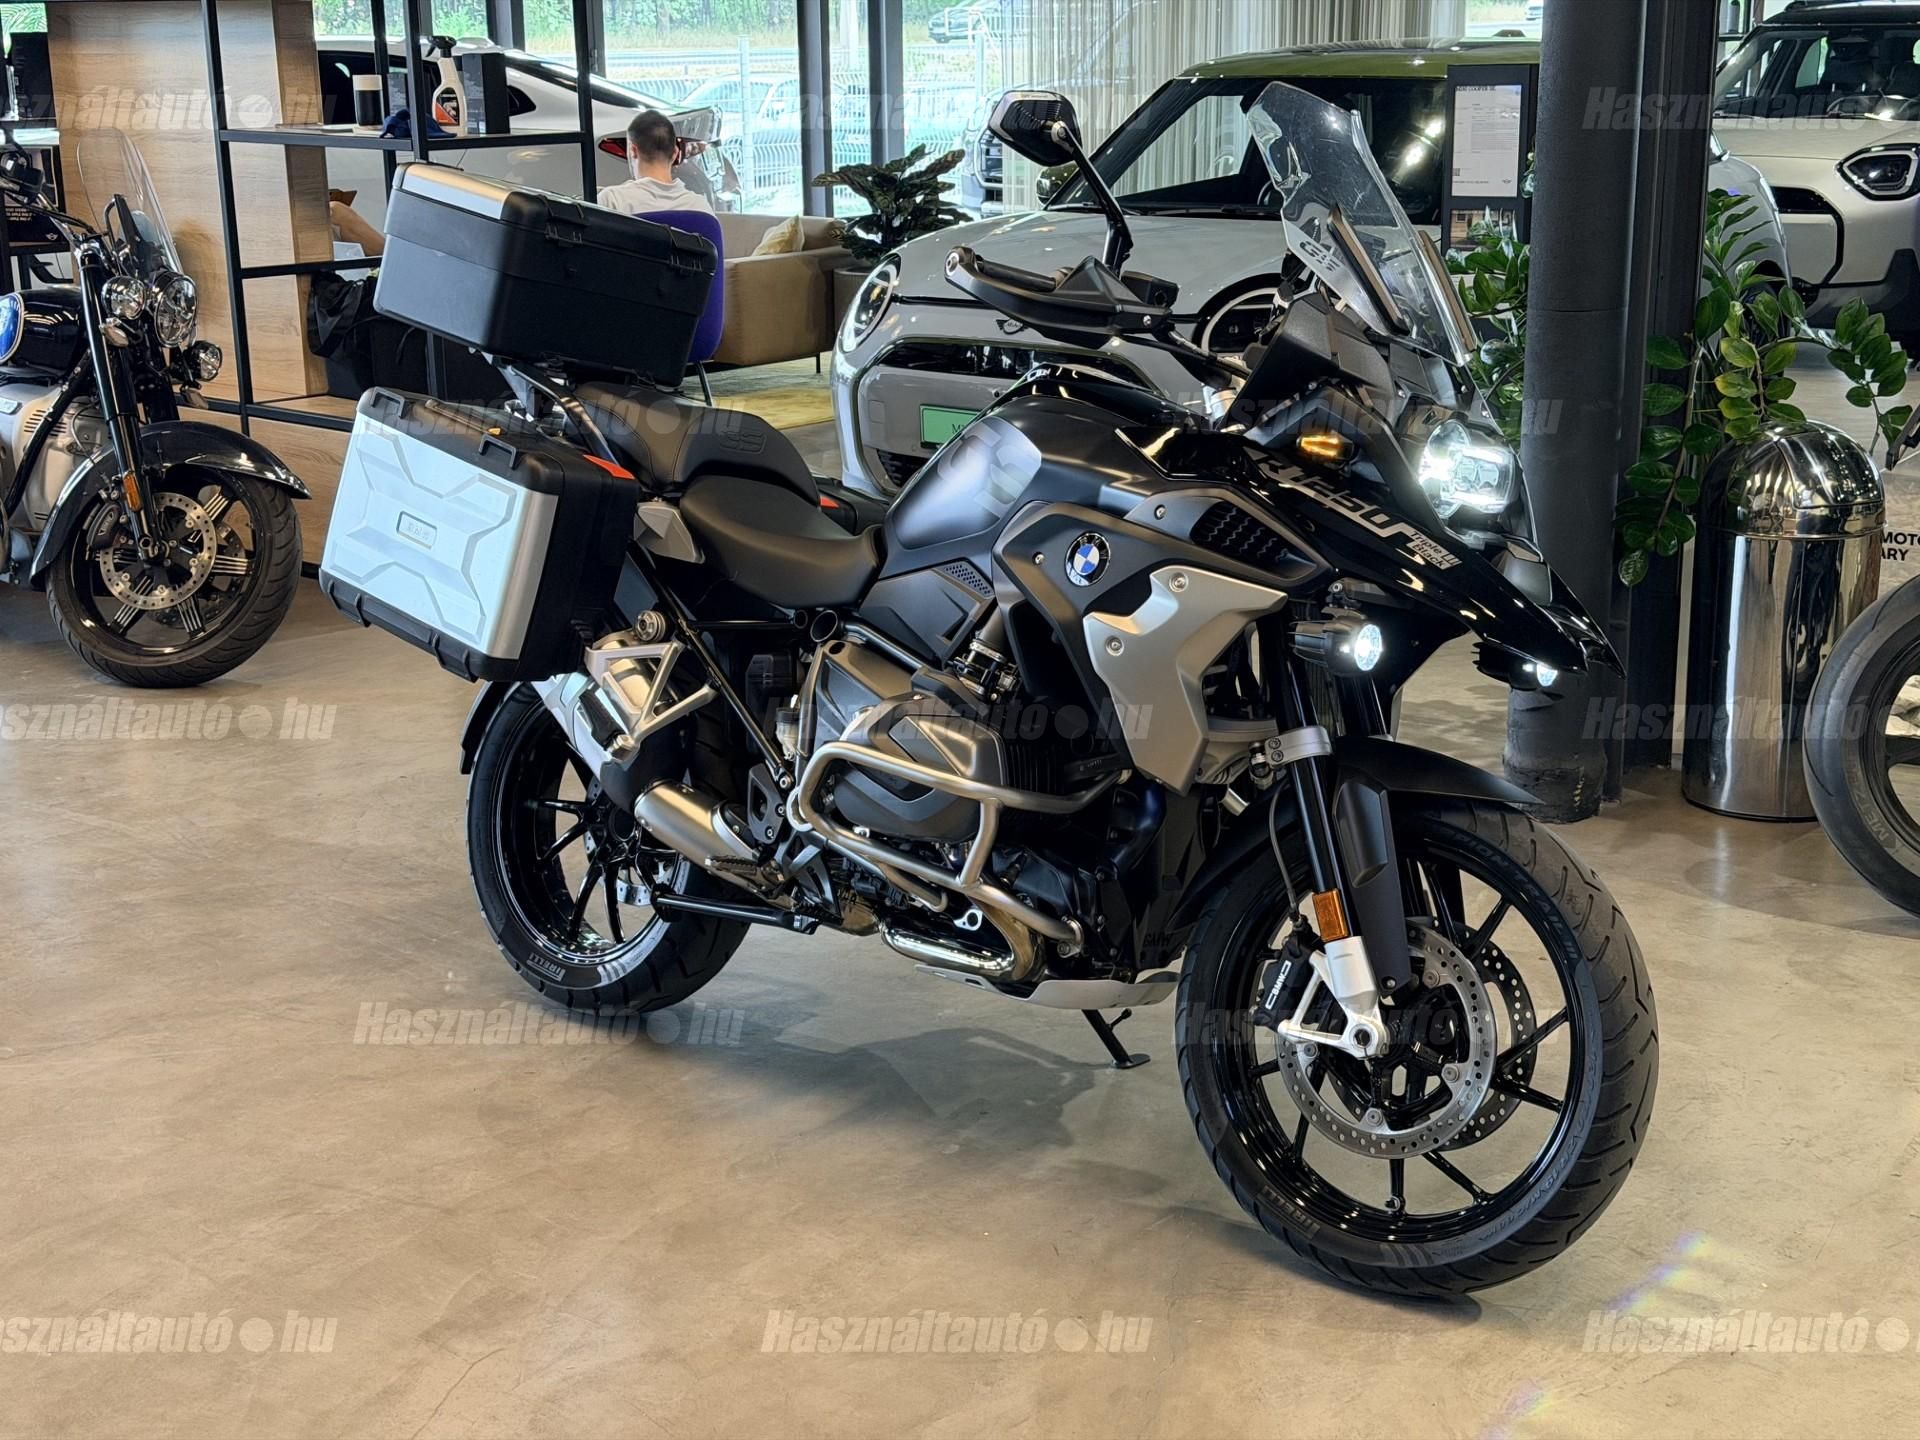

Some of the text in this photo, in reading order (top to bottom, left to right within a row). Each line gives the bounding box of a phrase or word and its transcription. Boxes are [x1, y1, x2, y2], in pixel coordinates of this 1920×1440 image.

[1410, 530, 1443, 555] Triple
[1881, 531, 1920, 546] MOT
[1411, 543, 1446, 567] Black
[526, 952, 566, 982] PIRELLI
